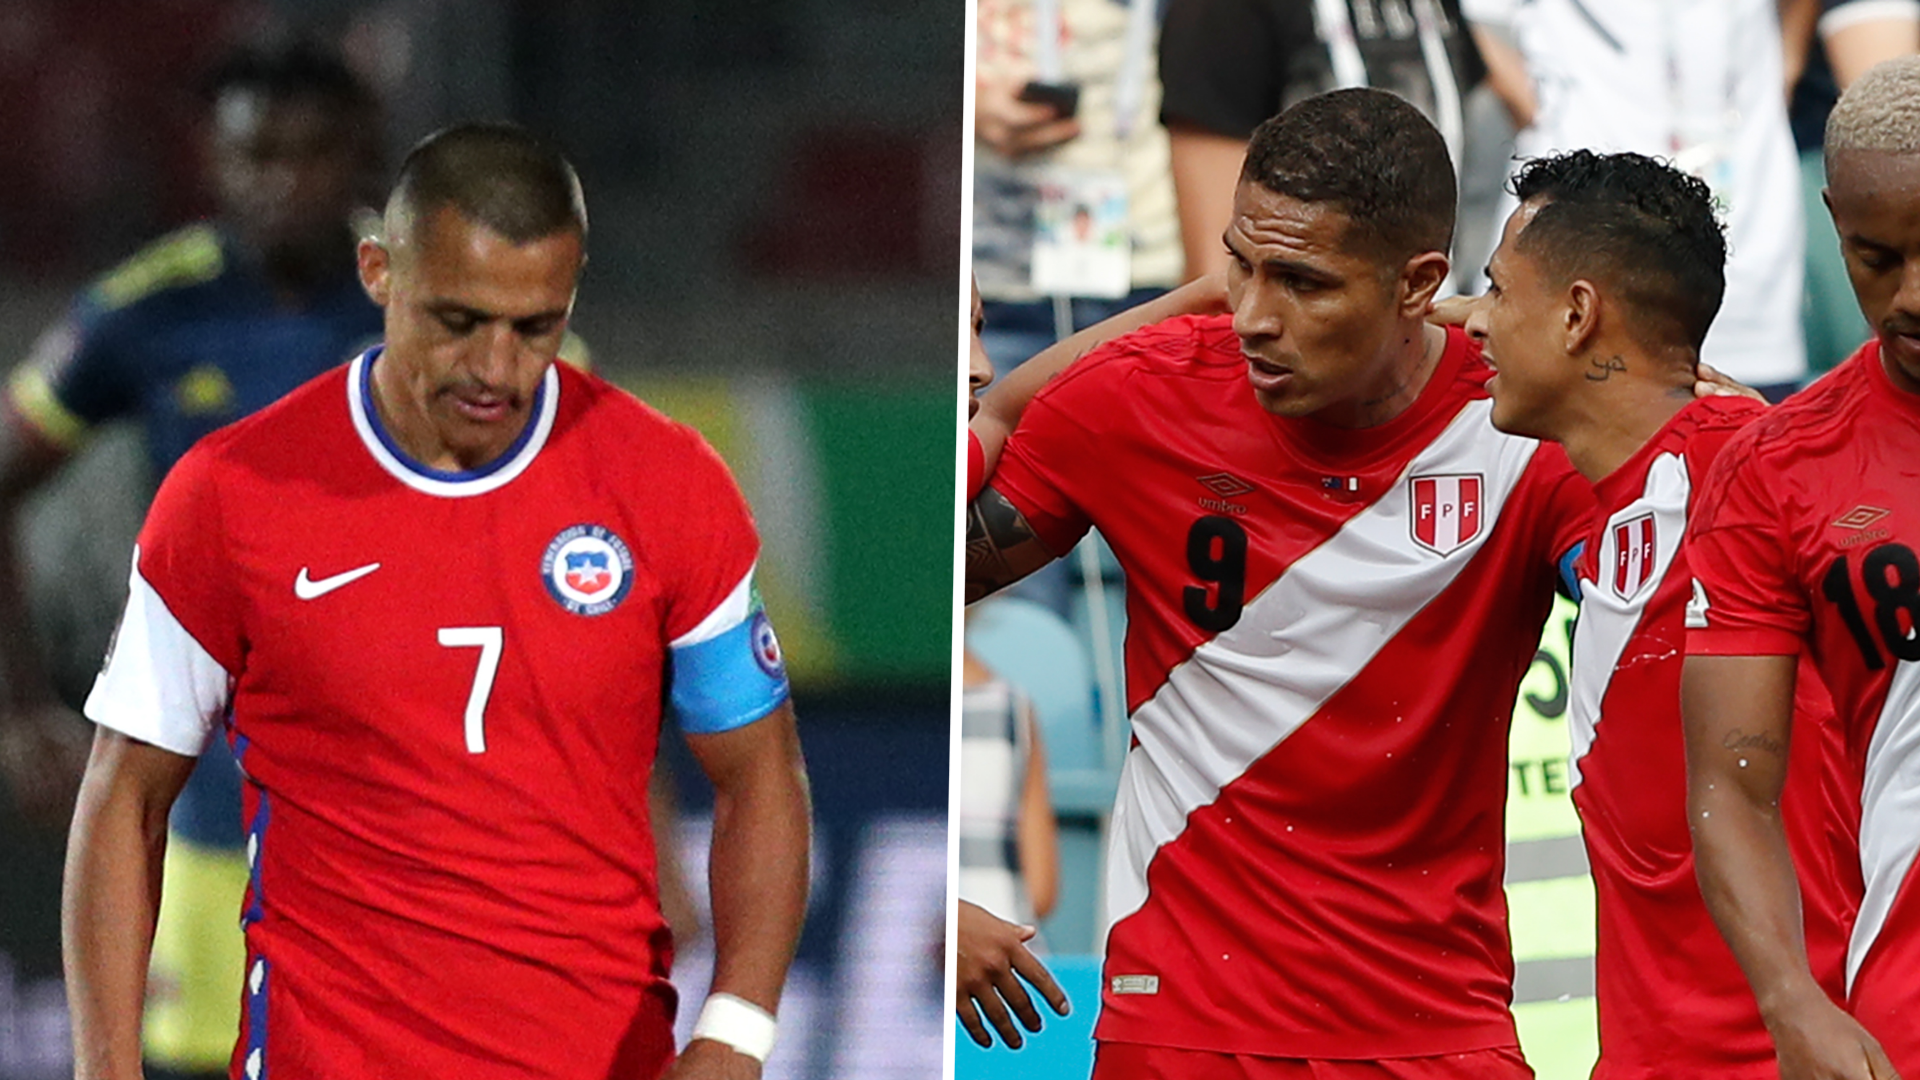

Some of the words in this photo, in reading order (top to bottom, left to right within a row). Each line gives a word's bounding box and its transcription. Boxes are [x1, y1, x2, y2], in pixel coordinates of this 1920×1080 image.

[1198, 496, 1247, 514] umbro
[1839, 529, 1888, 546] umbro
[1183, 515, 1248, 632] 9
[1822, 543, 1920, 671] 18
[437, 626, 505, 754] 7
